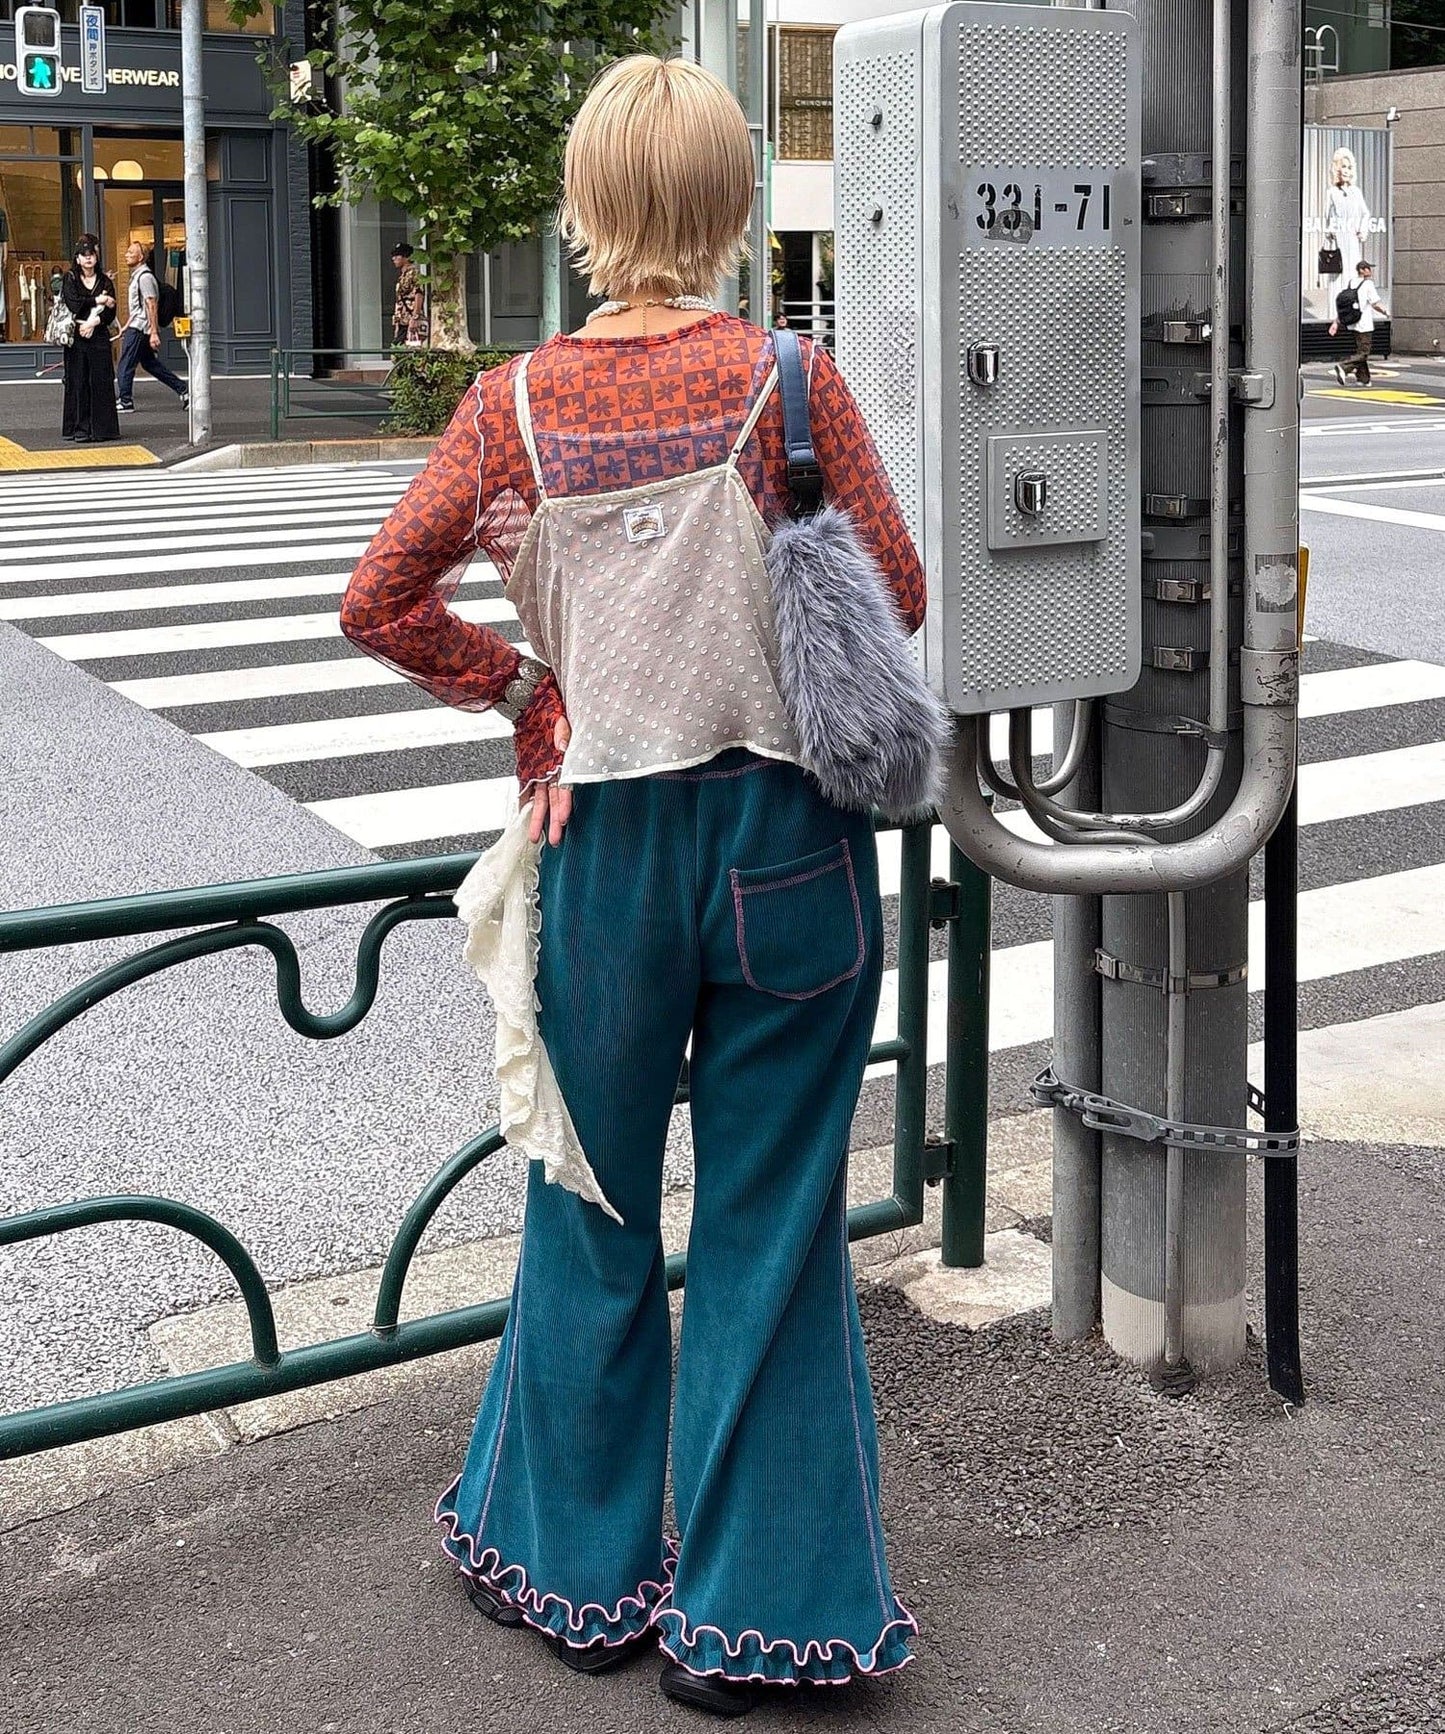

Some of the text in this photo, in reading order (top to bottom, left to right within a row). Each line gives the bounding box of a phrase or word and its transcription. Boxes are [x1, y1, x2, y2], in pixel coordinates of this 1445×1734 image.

[60, 66, 180, 87] WEHERWEAR
[976, 183, 1110, 230] 331-71
[1303, 217, 1387, 233] BALENGA
